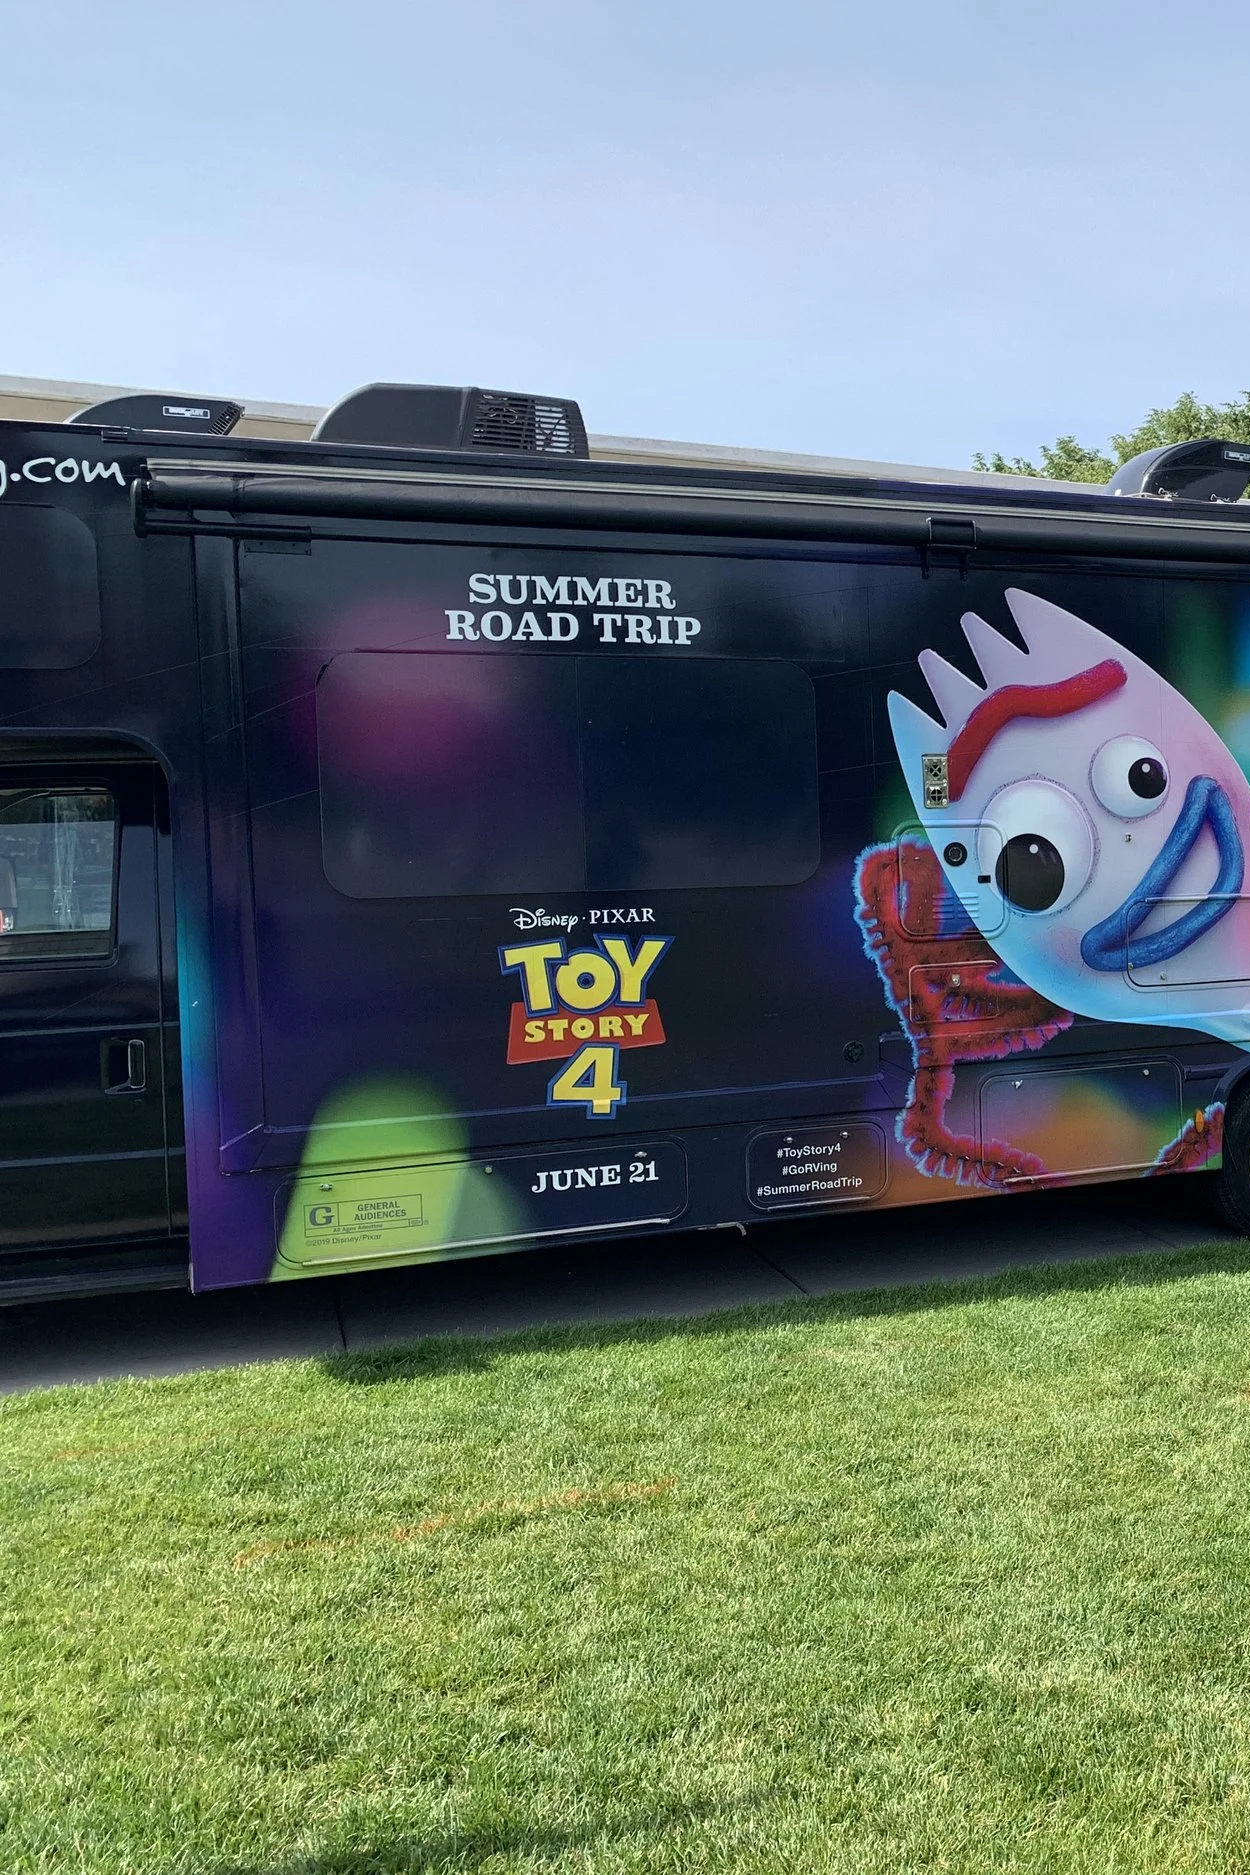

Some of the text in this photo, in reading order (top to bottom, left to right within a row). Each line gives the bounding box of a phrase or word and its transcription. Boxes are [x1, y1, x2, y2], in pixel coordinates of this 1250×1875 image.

[469, 573, 676, 609] SUMMER
[445, 609, 701, 644] ROAD TRIP
[509, 907, 655, 932] Disney PIXAR
[499, 934, 674, 1016] TOY
[524, 1013, 650, 1043] STORY
[547, 1042, 627, 1119] 4
[777, 1143, 841, 1158] #ToyStory4
[531, 1160, 659, 1193] JUNE 21
[782, 1161, 837, 1176] #GoRVing
[757, 1176, 862, 1196] #SummerRoadTrip
[309, 1206, 335, 1226] G
[354, 1209, 406, 1221] AUDIENCES
[357, 1201, 400, 1212] GENERAL
[332, 1233, 382, 1244] Disney/Pixar
